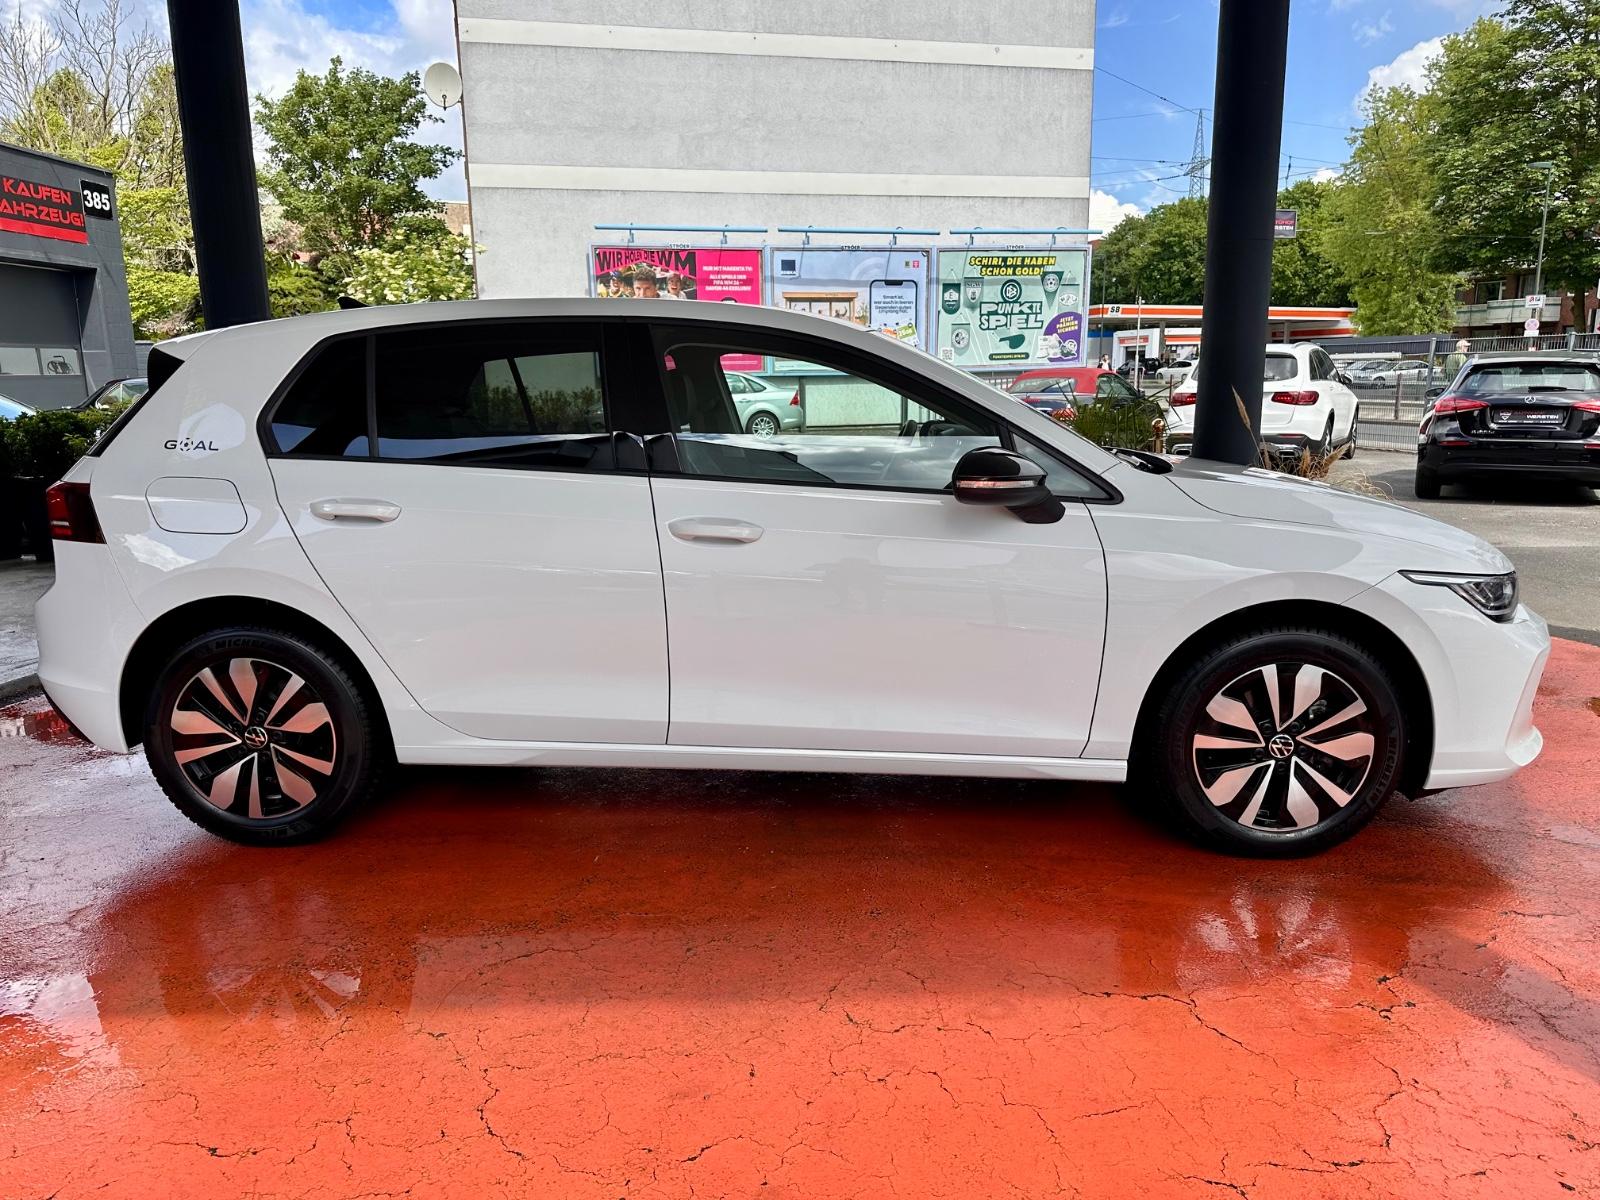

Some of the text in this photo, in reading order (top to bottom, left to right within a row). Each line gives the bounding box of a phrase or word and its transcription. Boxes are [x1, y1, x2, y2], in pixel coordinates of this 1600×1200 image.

[2, 177, 72, 206] KAUFEN
[83, 189, 111, 211] 385
[597, 250, 623, 272] WIR
[624, 249, 643, 264] HOLEN
[656, 250, 697, 277] WM
[969, 256, 1056, 266] SCHIRI, DIE HABEN
[980, 266, 1044, 276] SCHON GOLD!
[980, 302, 1042, 314] PUNKTE
[980, 314, 1043, 330] SPIEL
